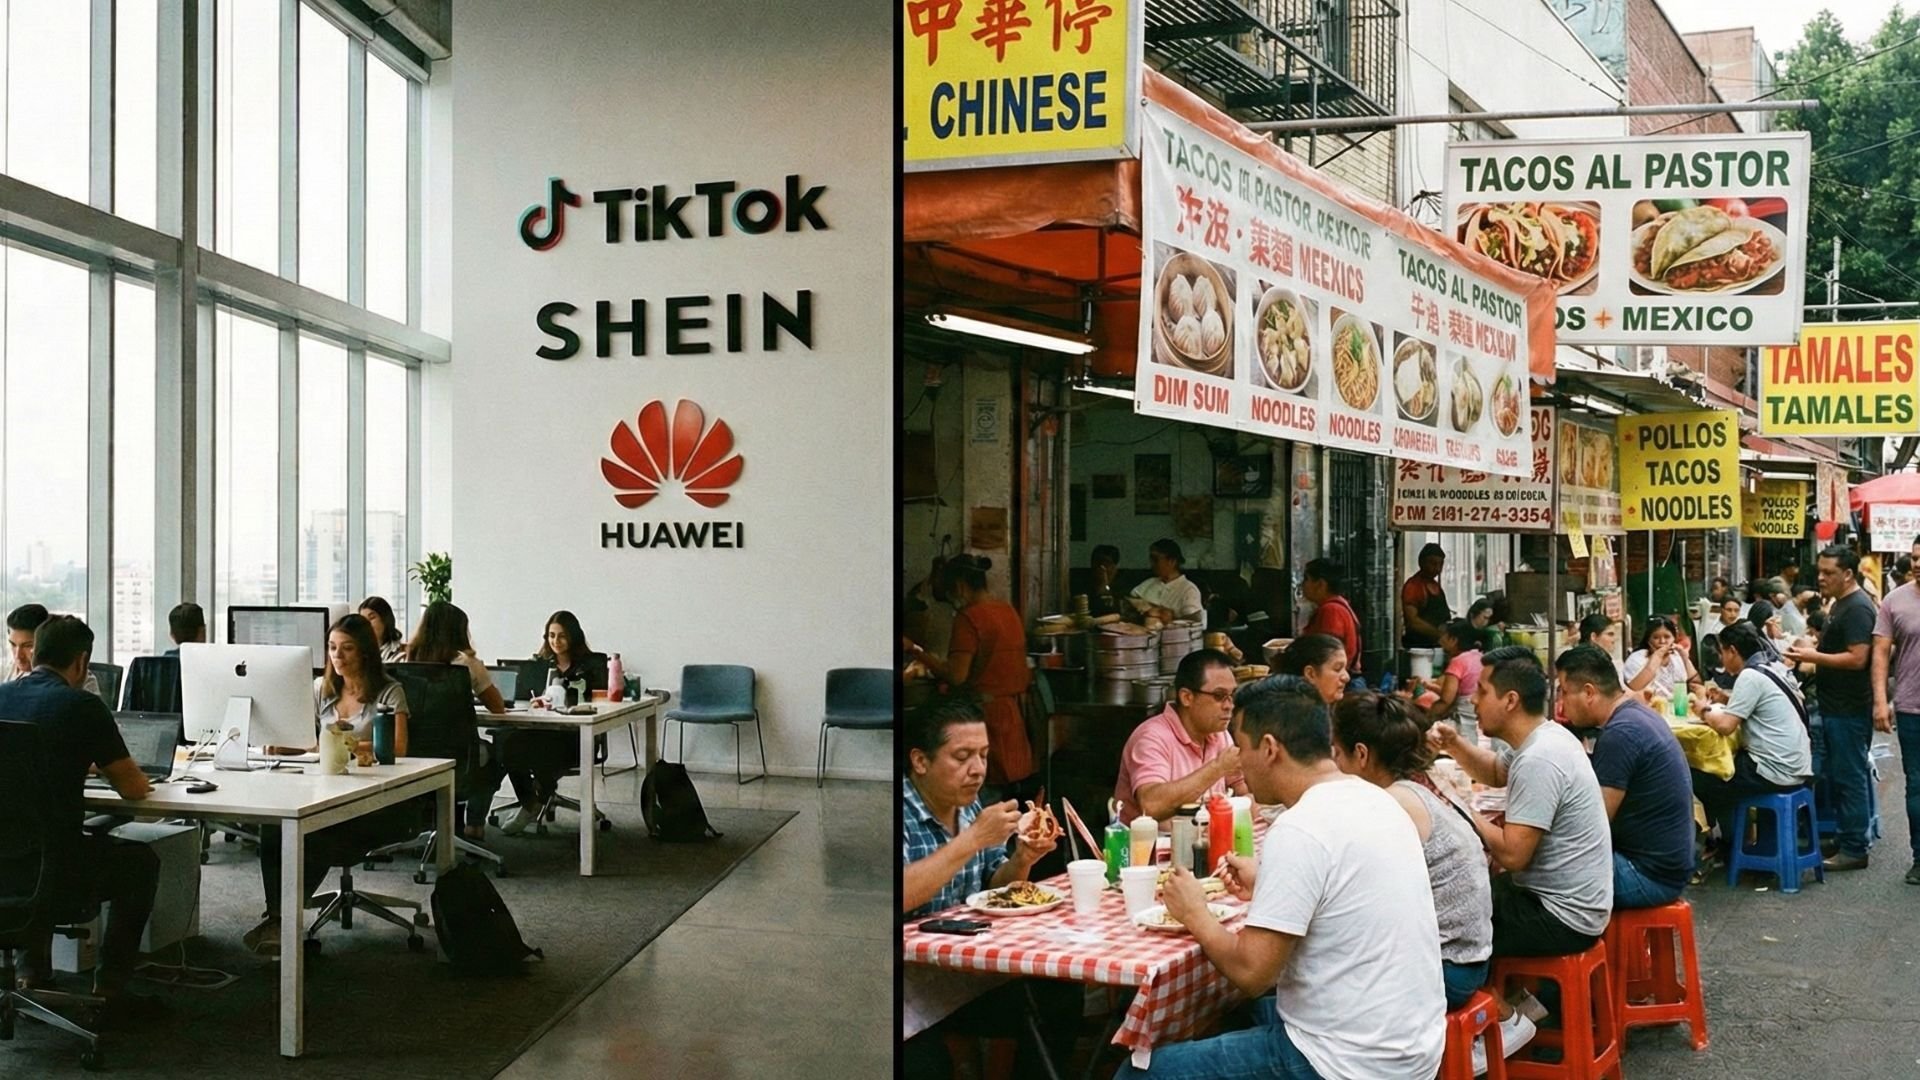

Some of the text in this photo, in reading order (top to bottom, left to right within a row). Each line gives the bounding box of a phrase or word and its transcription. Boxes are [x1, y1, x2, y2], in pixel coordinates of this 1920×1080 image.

[930, 70, 1107, 139] CHINESE
[1162, 127, 1233, 193] TACOS
[1255, 176, 1313, 234] PASTOR
[1460, 149, 1791, 193] TACOS AL PASTOR
[593, 174, 830, 244] TikTok
[1397, 248, 1448, 296] TACOS
[1450, 273, 1468, 305] AL
[1472, 283, 1522, 329] PASTOR
[535, 289, 814, 361] SHEIN
[1622, 305, 1754, 332] MEXICO
[1766, 333, 1914, 385] TAMALES
[1153, 374, 1230, 415] DIM SUM
[1766, 394, 1914, 425] TAMALES
[1251, 394, 1316, 432] NOODLES
[1329, 413, 1382, 444] NOODLES
[1638, 421, 1728, 451] POLLOS
[1645, 458, 1721, 486] TACOS
[1641, 494, 1733, 522] NOODLES
[1761, 497, 1800, 509] POLLOS
[1763, 508, 1795, 521] TACOS
[600, 521, 744, 549] HUAWEI
[1753, 521, 1799, 535] NOODLES
